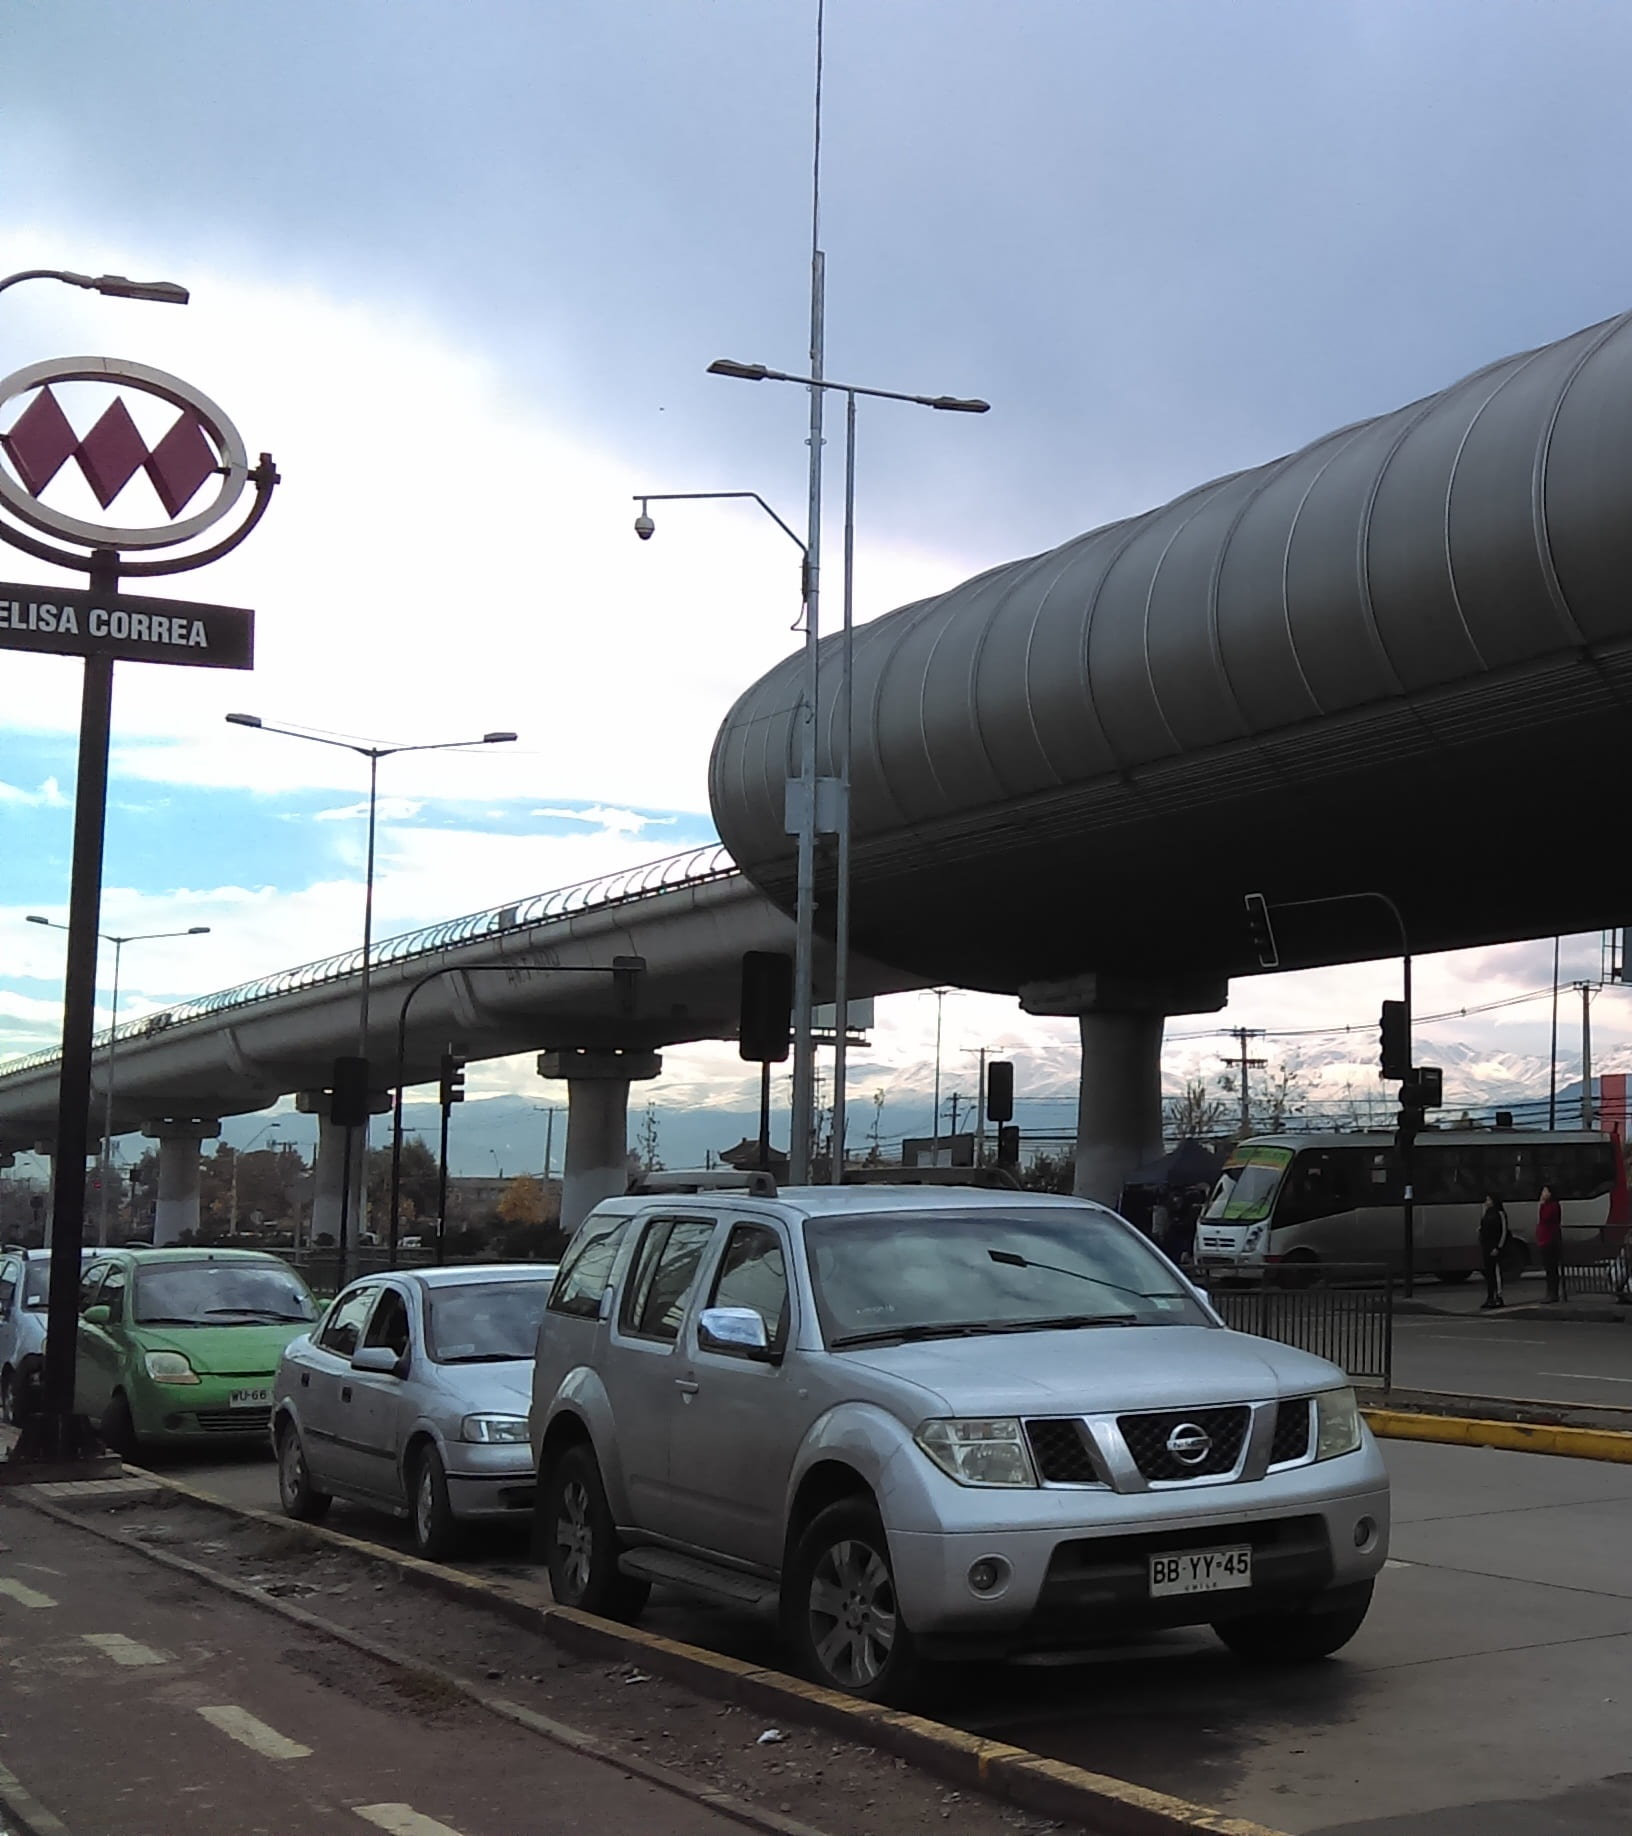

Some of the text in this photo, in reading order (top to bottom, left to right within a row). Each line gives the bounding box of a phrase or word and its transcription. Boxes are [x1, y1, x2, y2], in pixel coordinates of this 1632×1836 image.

[0, 600, 208, 648] ELISA CORREA
[1184, 1582, 1218, 1592] CHILE
